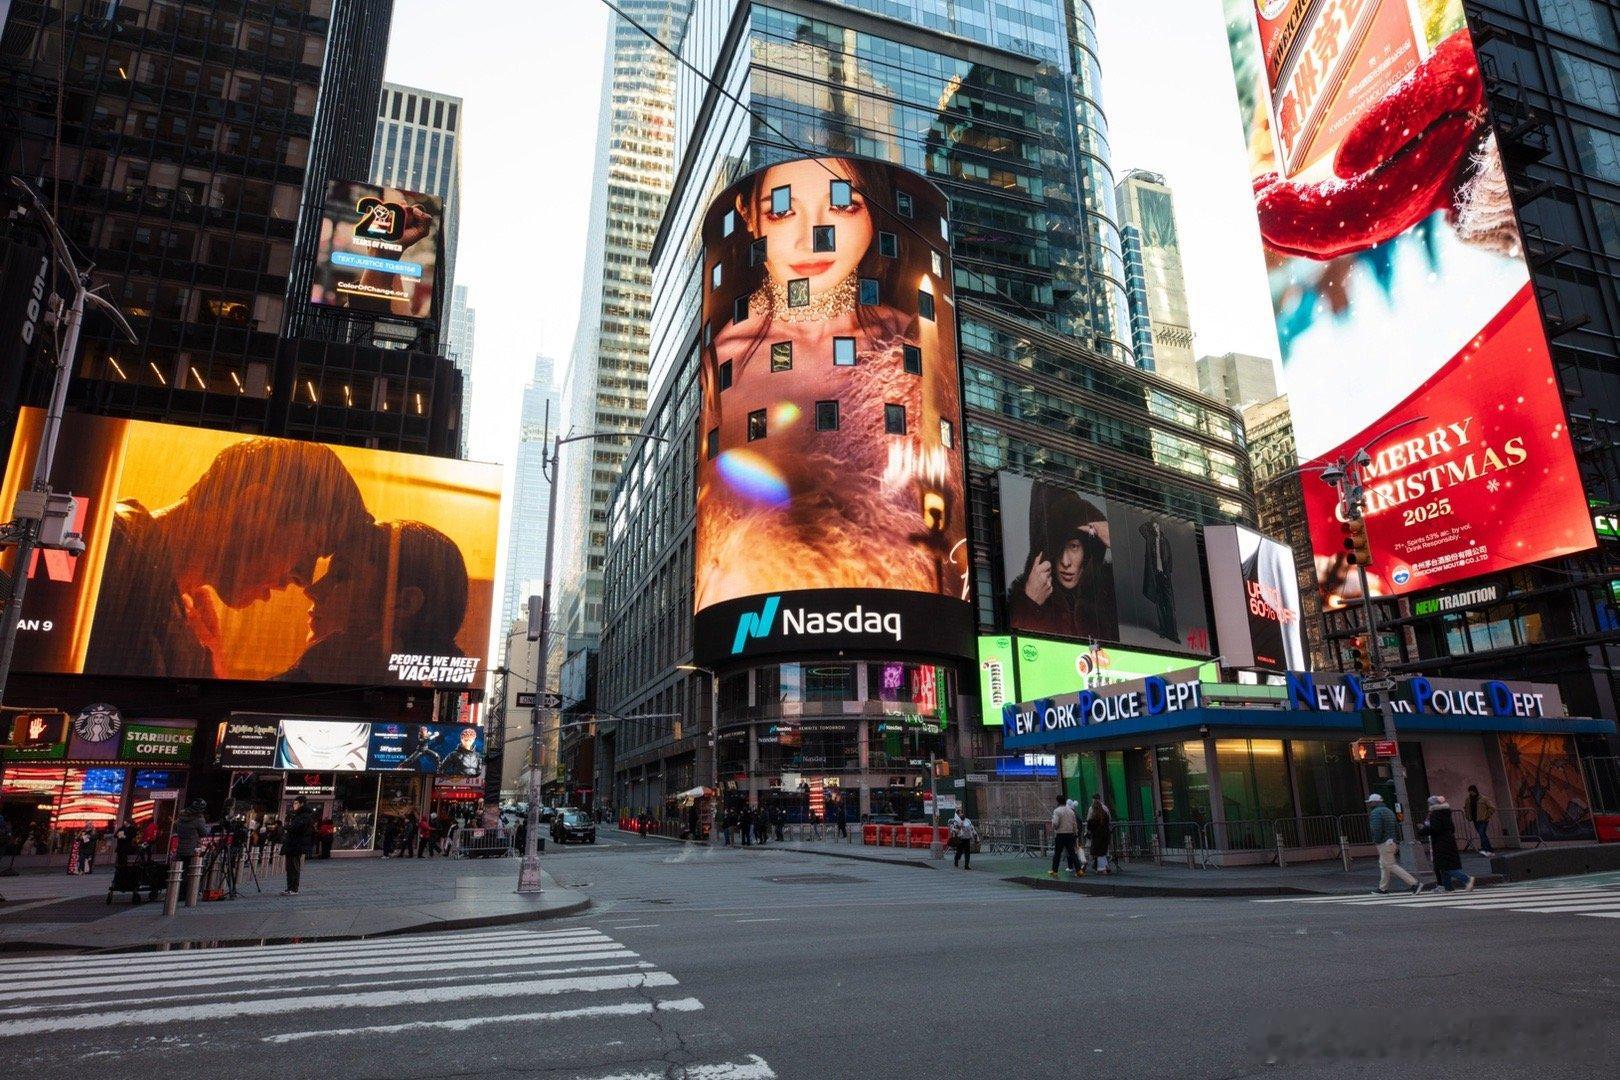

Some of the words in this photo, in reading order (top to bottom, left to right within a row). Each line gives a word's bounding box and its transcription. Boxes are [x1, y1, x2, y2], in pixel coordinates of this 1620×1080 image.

[353, 238, 371, 247] YEARS
[371, 241, 380, 249] OF
[380, 242, 403, 252] POWER
[338, 255, 354, 263] TEXT
[337, 281, 409, 297] ColorOfChange.org
[1362, 416, 1474, 483] MERRY
[1402, 498, 1452, 526] 2025
[1406, 544, 1422, 554] Drink
[1407, 535, 1425, 548] Spirits
[1247, 580, 1263, 600] UP
[1249, 598, 1276, 621] 60%
[17, 619, 39, 631] AN
[43, 620, 53, 632] 9
[782, 605, 902, 642] Nasdaq
[389, 654, 432, 666] PEOPLE
[432, 656, 450, 667] WE
[450, 657, 480, 668] MEET
[398, 665, 476, 683] VACATION
[1078, 689, 1140, 726] POLICE
[1145, 675, 1200, 716] DEPT
[1287, 671, 1346, 712] NEW
[1410, 676, 1488, 715] POLICE
[1482, 680, 1544, 717] DEPT
[127, 731, 193, 744] STARBUCKS
[136, 744, 178, 755] COFFEE
